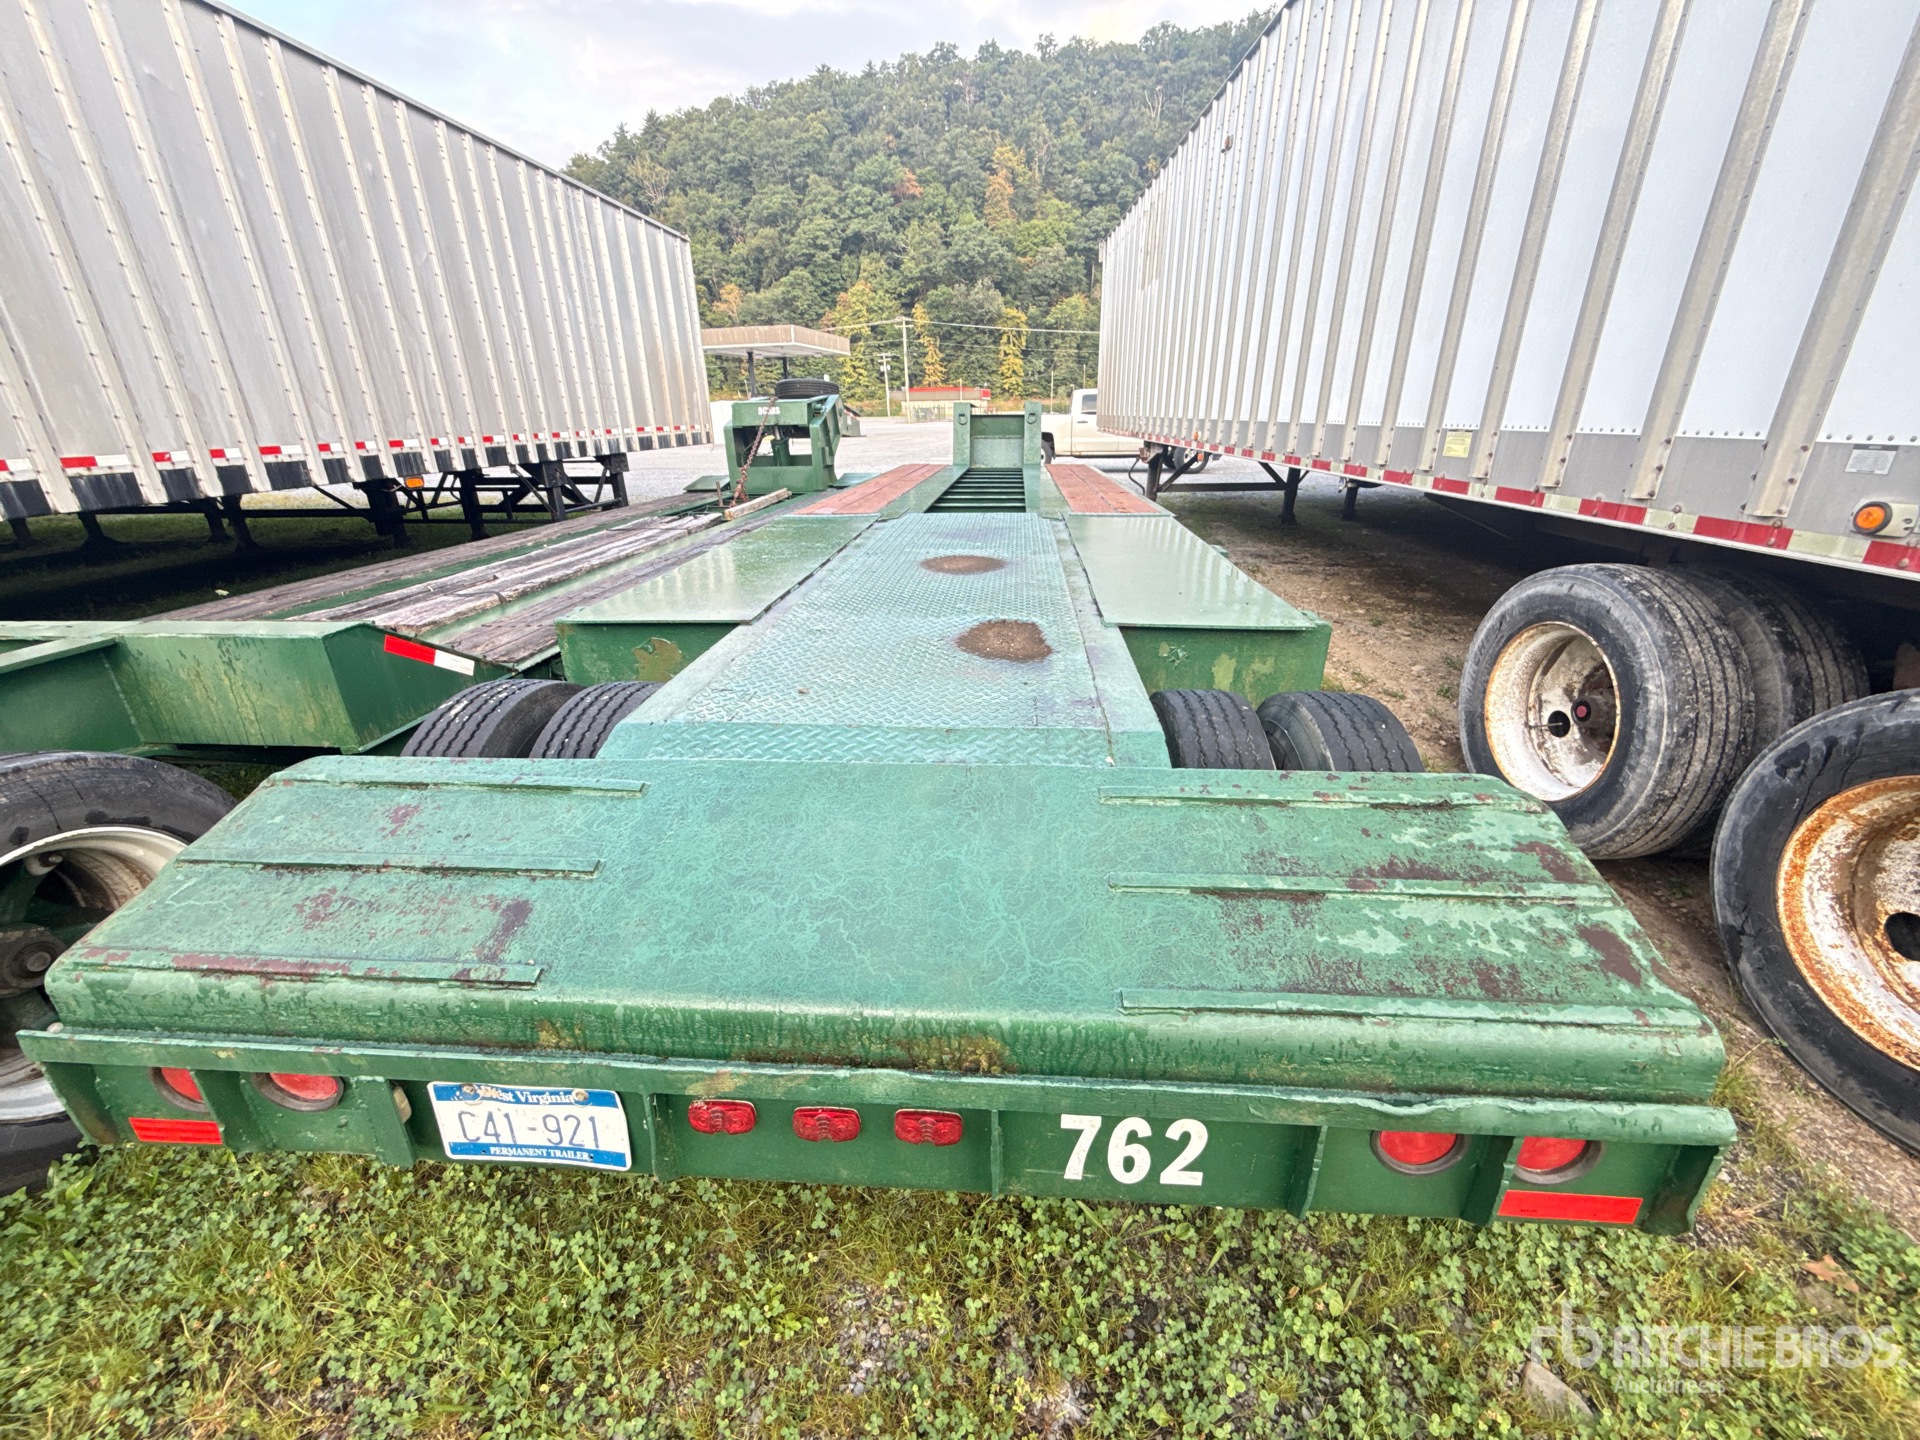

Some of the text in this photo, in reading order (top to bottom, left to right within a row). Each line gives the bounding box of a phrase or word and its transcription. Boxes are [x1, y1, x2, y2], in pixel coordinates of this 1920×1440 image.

[515, 1091, 575, 1105] Virginia
[489, 1145, 589, 1161] PERMANENT TRAILER
[1060, 1113, 1209, 1187] 762
